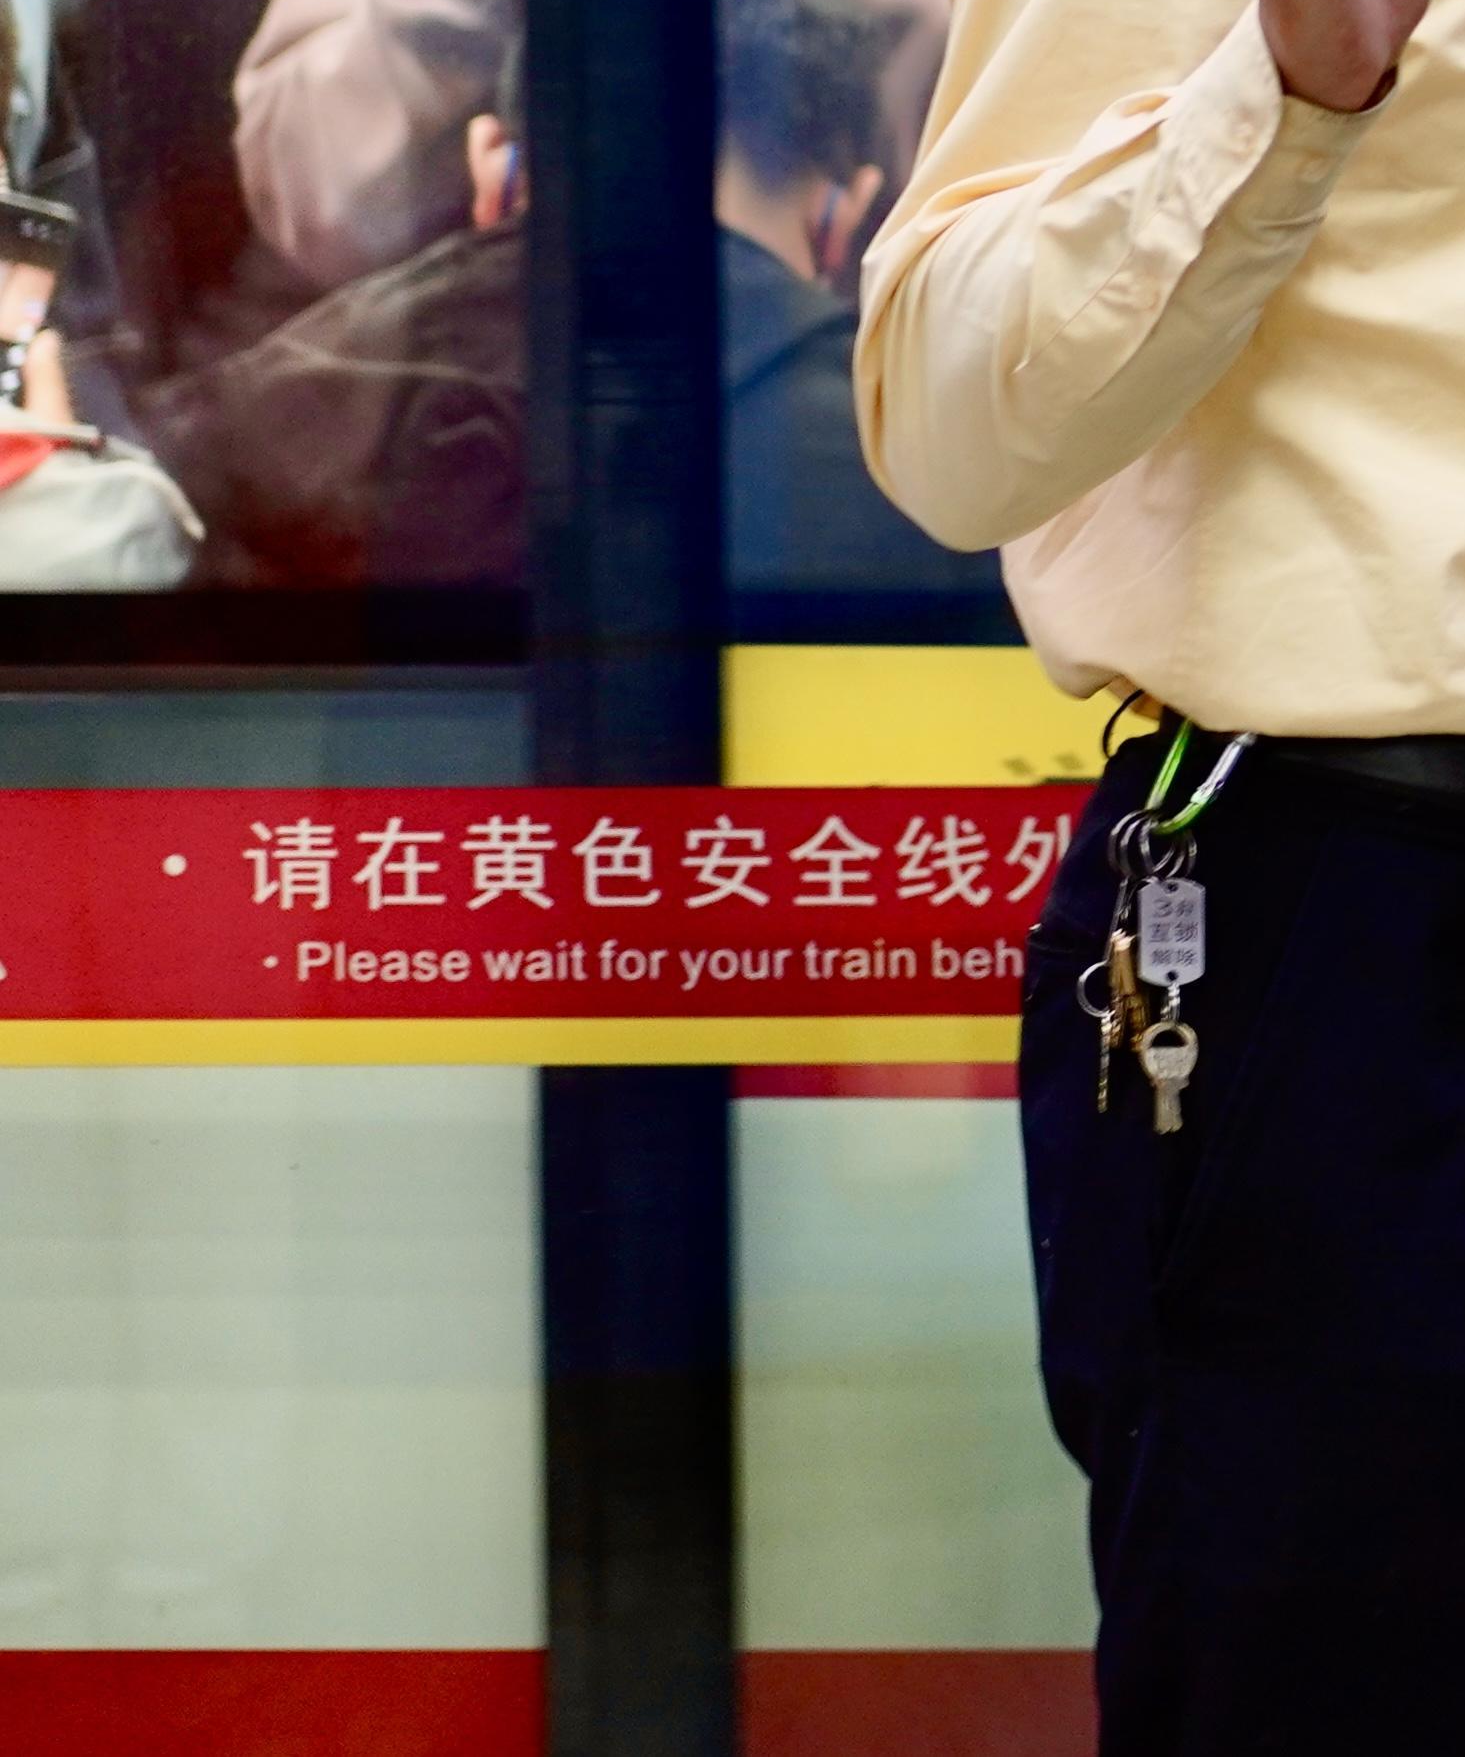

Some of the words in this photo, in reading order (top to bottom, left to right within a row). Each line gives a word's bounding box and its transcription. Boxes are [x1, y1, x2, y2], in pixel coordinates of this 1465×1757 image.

[243, 814, 1072, 910] 请在黄色安全线外
[297, 940, 471, 982] Please
[483, 941, 586, 981] wait
[599, 939, 666, 980] for
[681, 949, 790, 990] your
[804, 940, 916, 979] train
[932, 938, 1024, 979] beh
